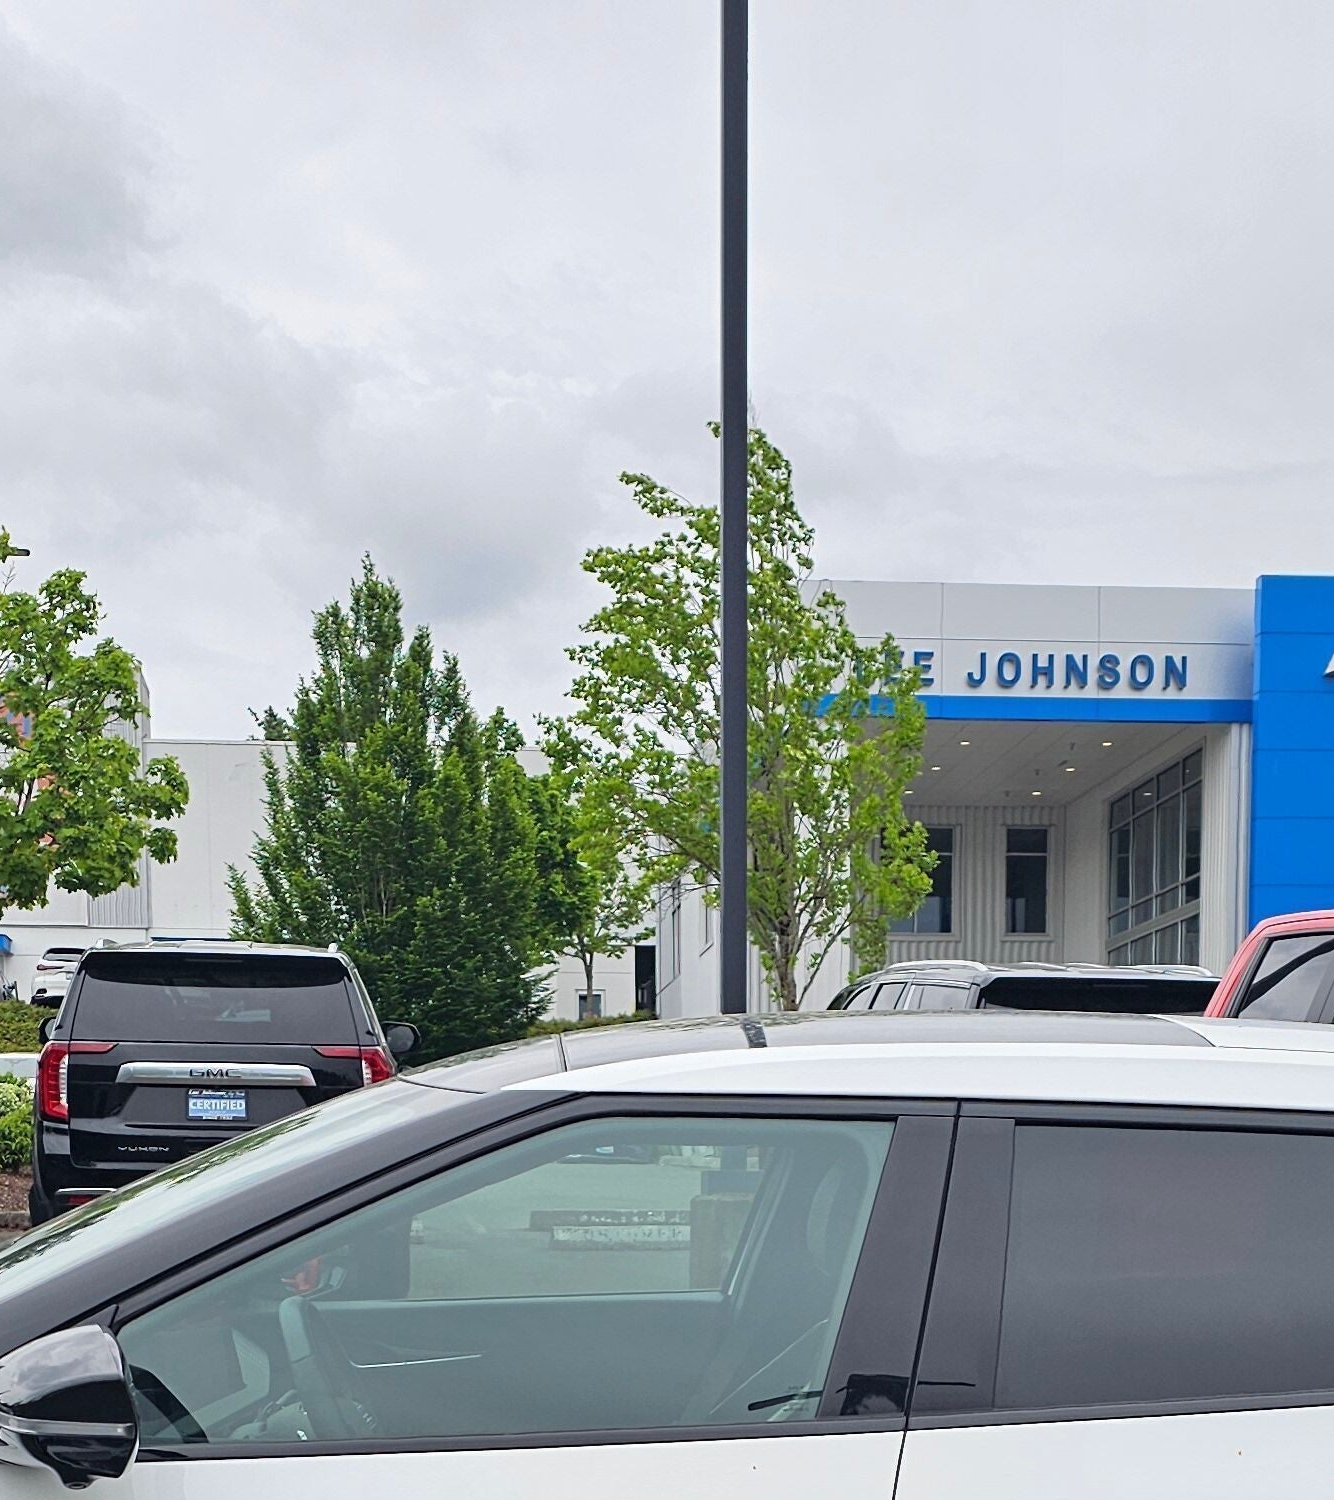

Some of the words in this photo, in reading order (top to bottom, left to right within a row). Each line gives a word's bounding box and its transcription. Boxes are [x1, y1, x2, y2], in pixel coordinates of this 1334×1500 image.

[967, 652, 1188, 690] JOHNSON
[189, 1069, 242, 1078] GMC
[189, 1100, 245, 1111] CERTIFIED
